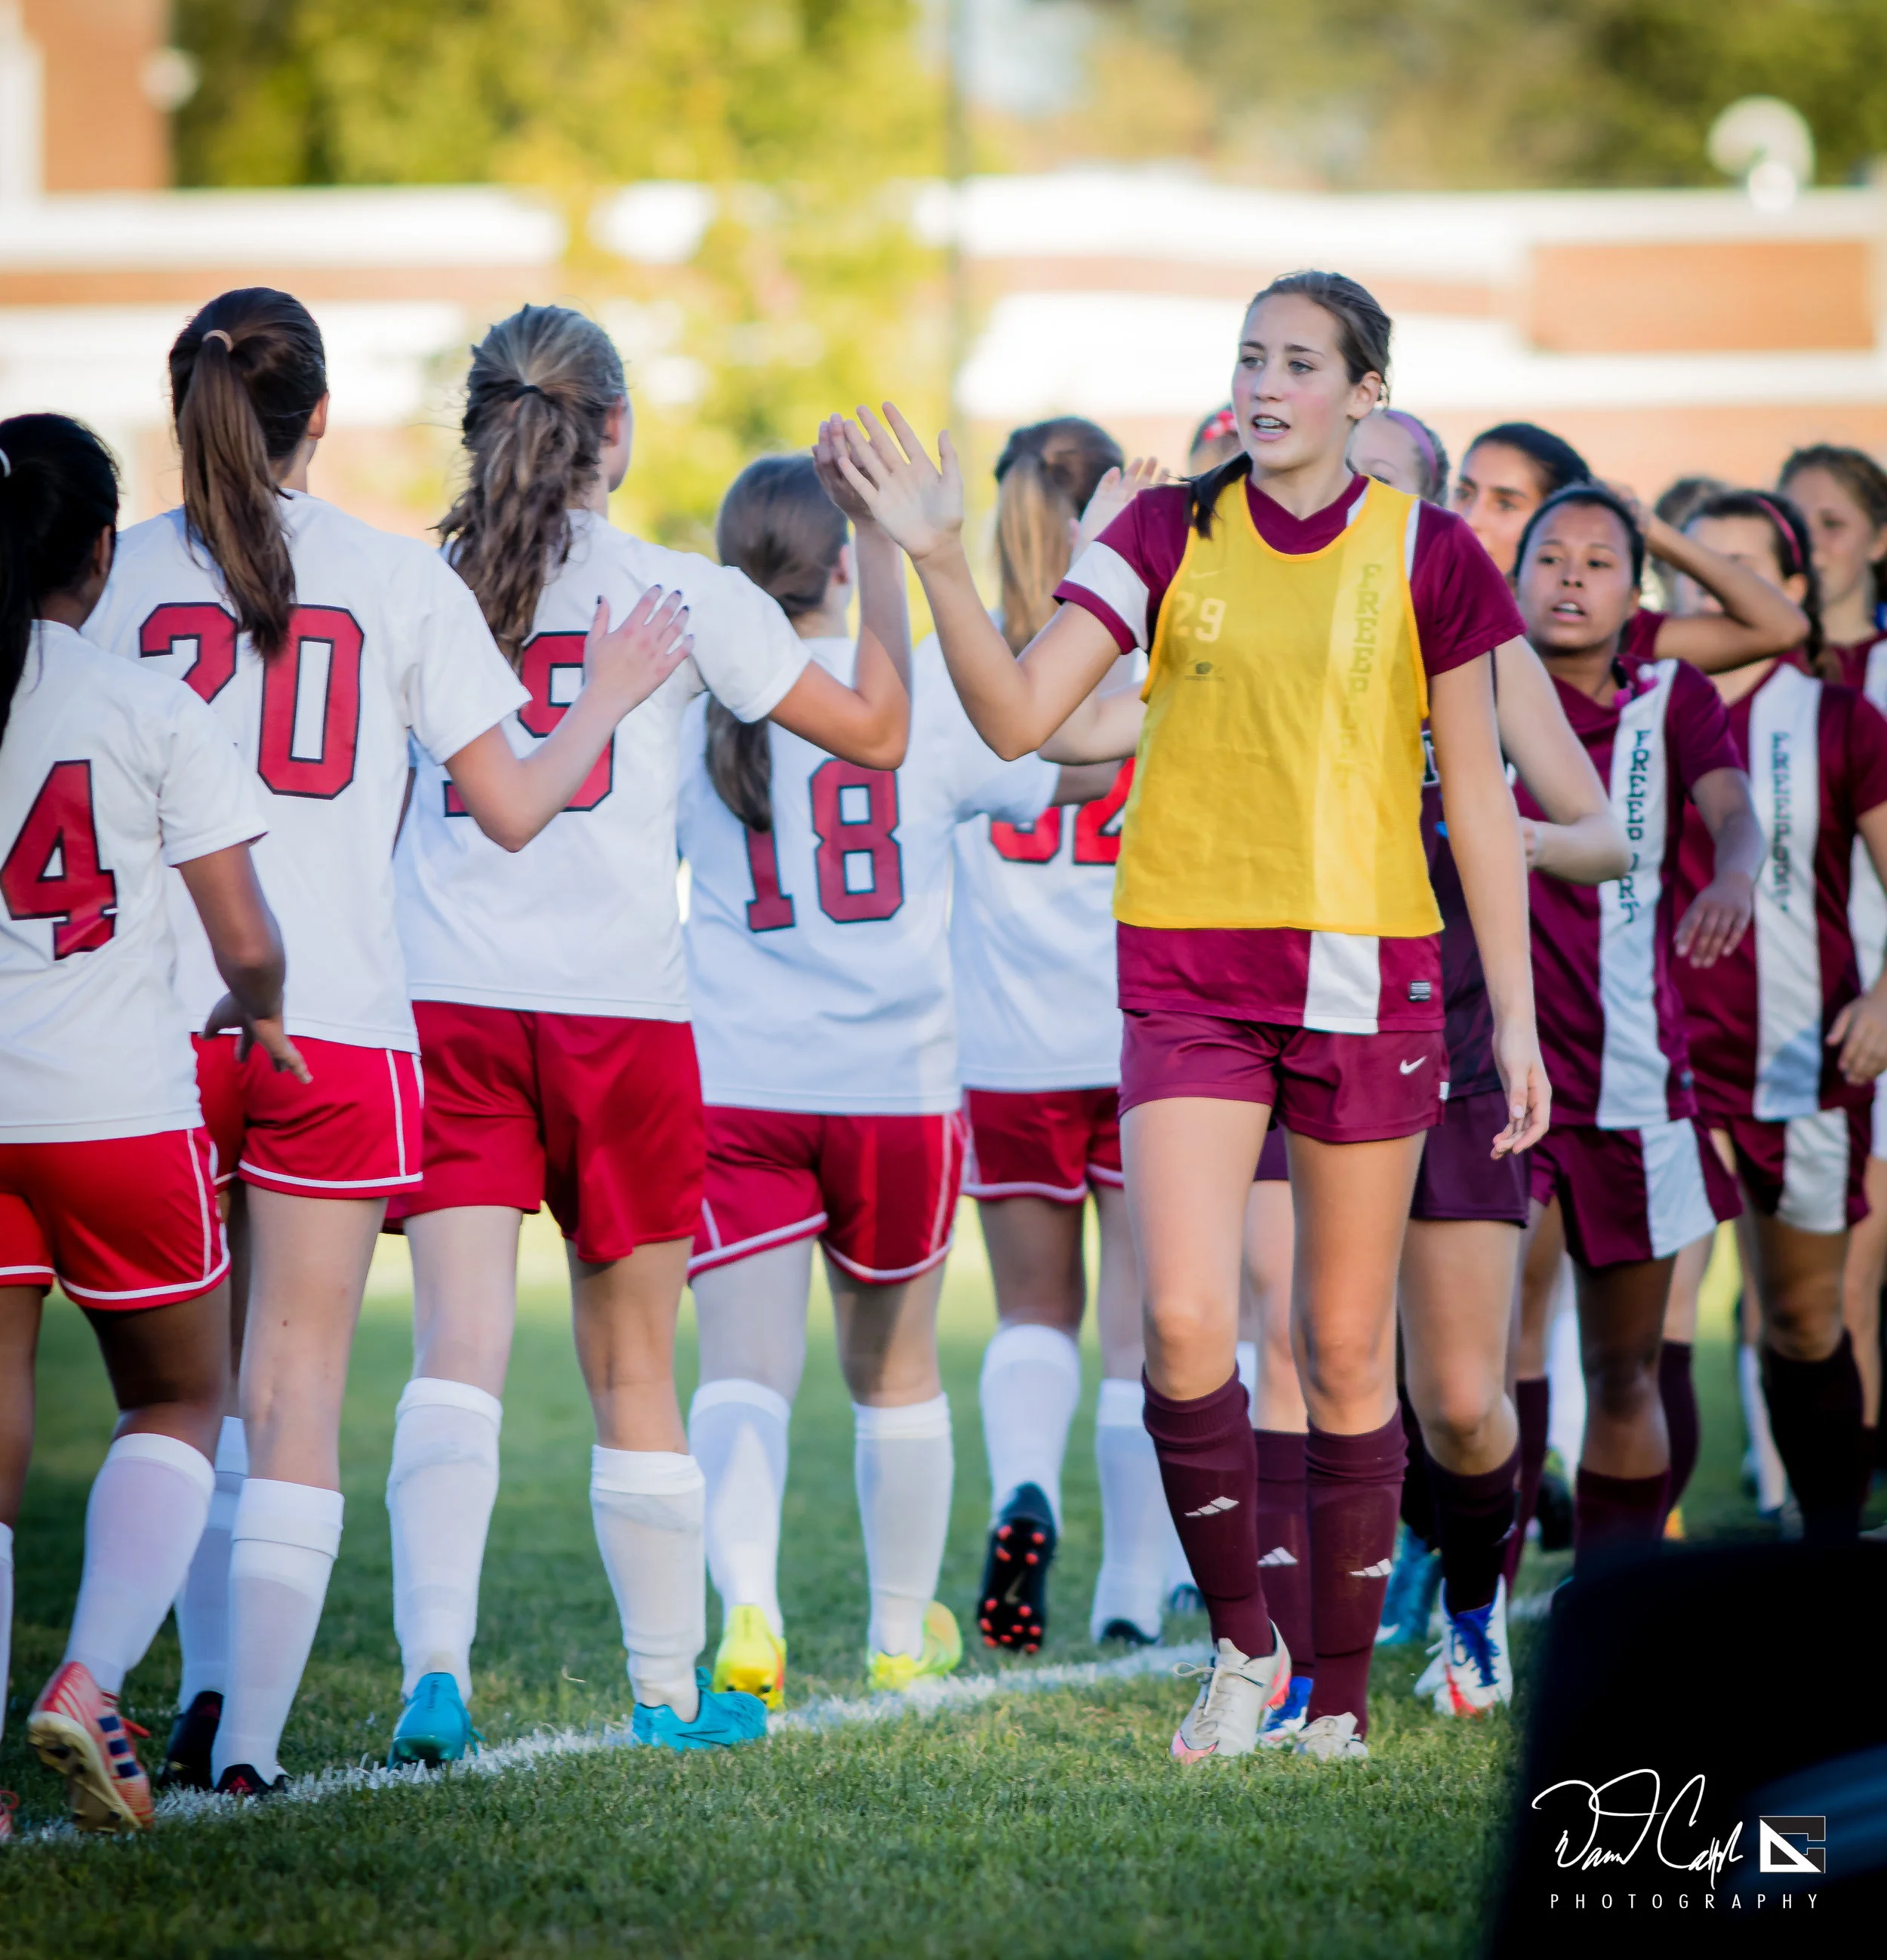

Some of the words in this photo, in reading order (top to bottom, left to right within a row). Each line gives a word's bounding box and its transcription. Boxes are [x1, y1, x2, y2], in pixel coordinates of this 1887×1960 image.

[140, 602, 365, 800] 20
[1173, 590, 1227, 642] 29
[0, 759, 118, 961] 4
[743, 757, 904, 933] 18
